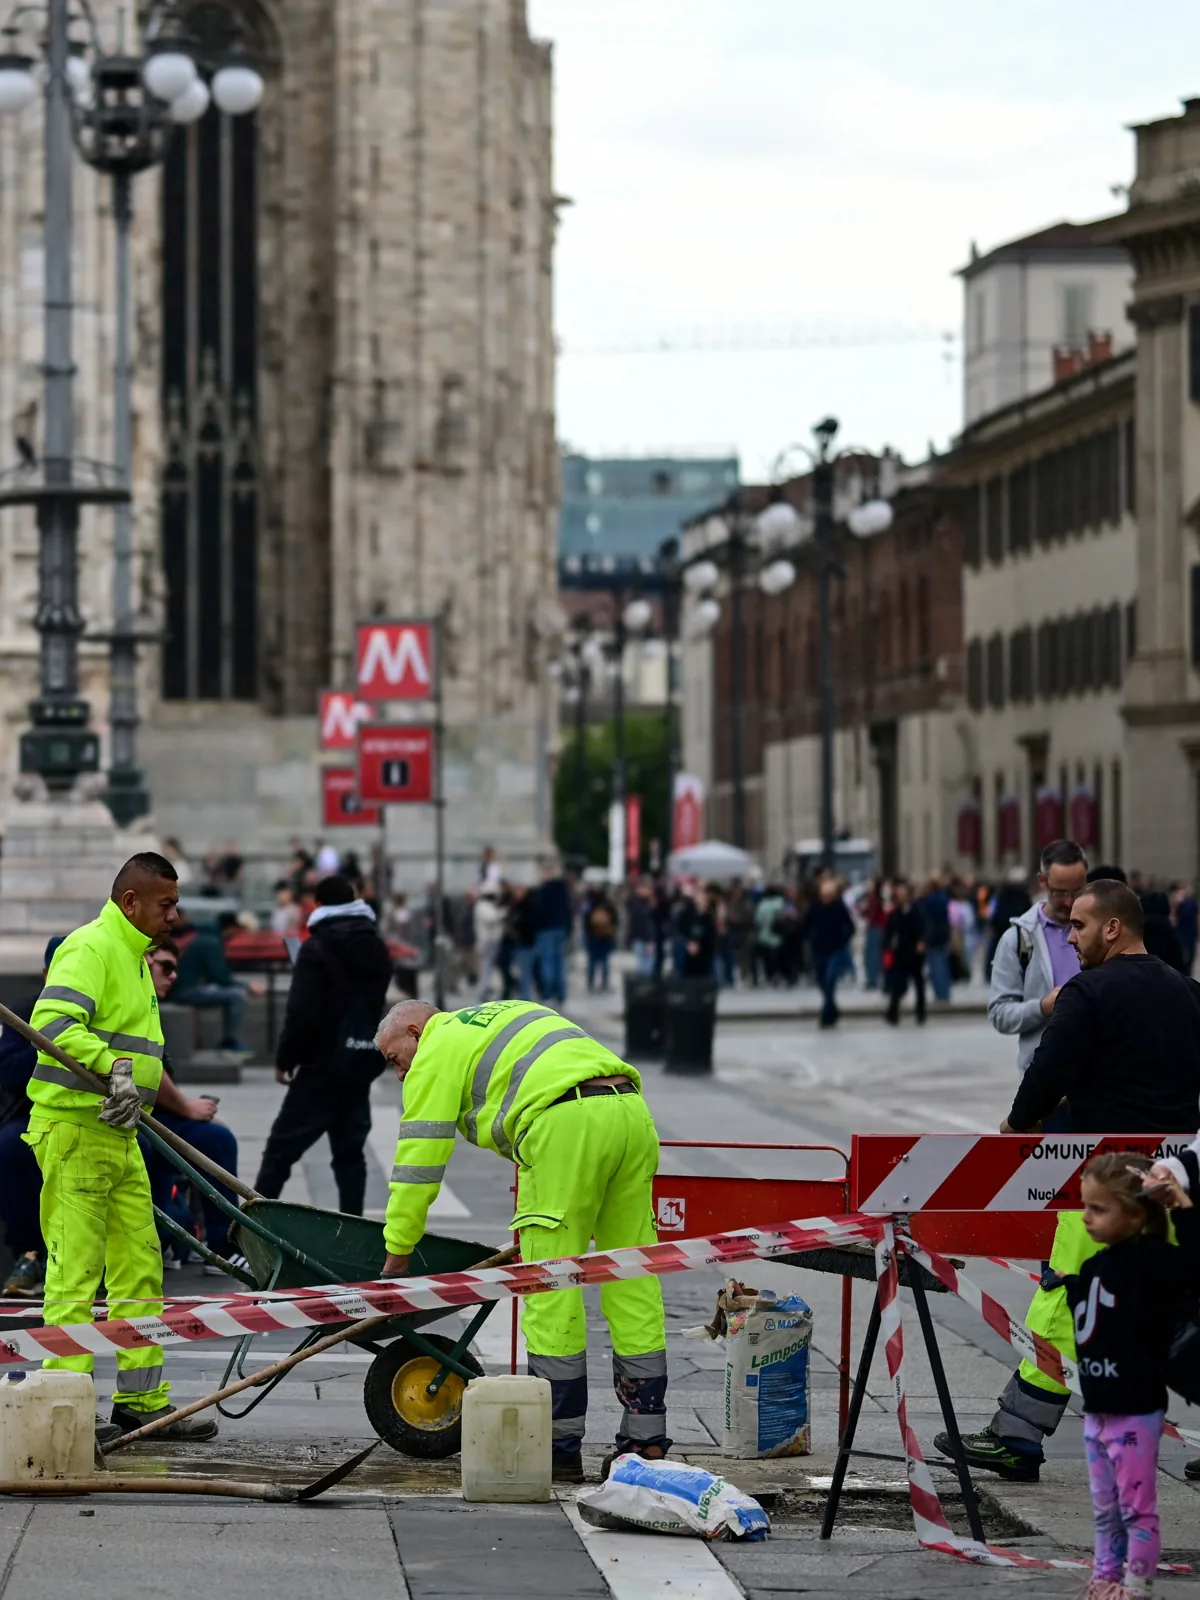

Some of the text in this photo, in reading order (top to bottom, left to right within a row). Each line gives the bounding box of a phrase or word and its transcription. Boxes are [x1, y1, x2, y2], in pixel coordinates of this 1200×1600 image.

[357, 629, 429, 684] M
[1020, 1144, 1096, 1160] COMUNE
[344, 1307, 367, 1315] COMUNE
[156, 1330, 179, 1339] COMUNE
